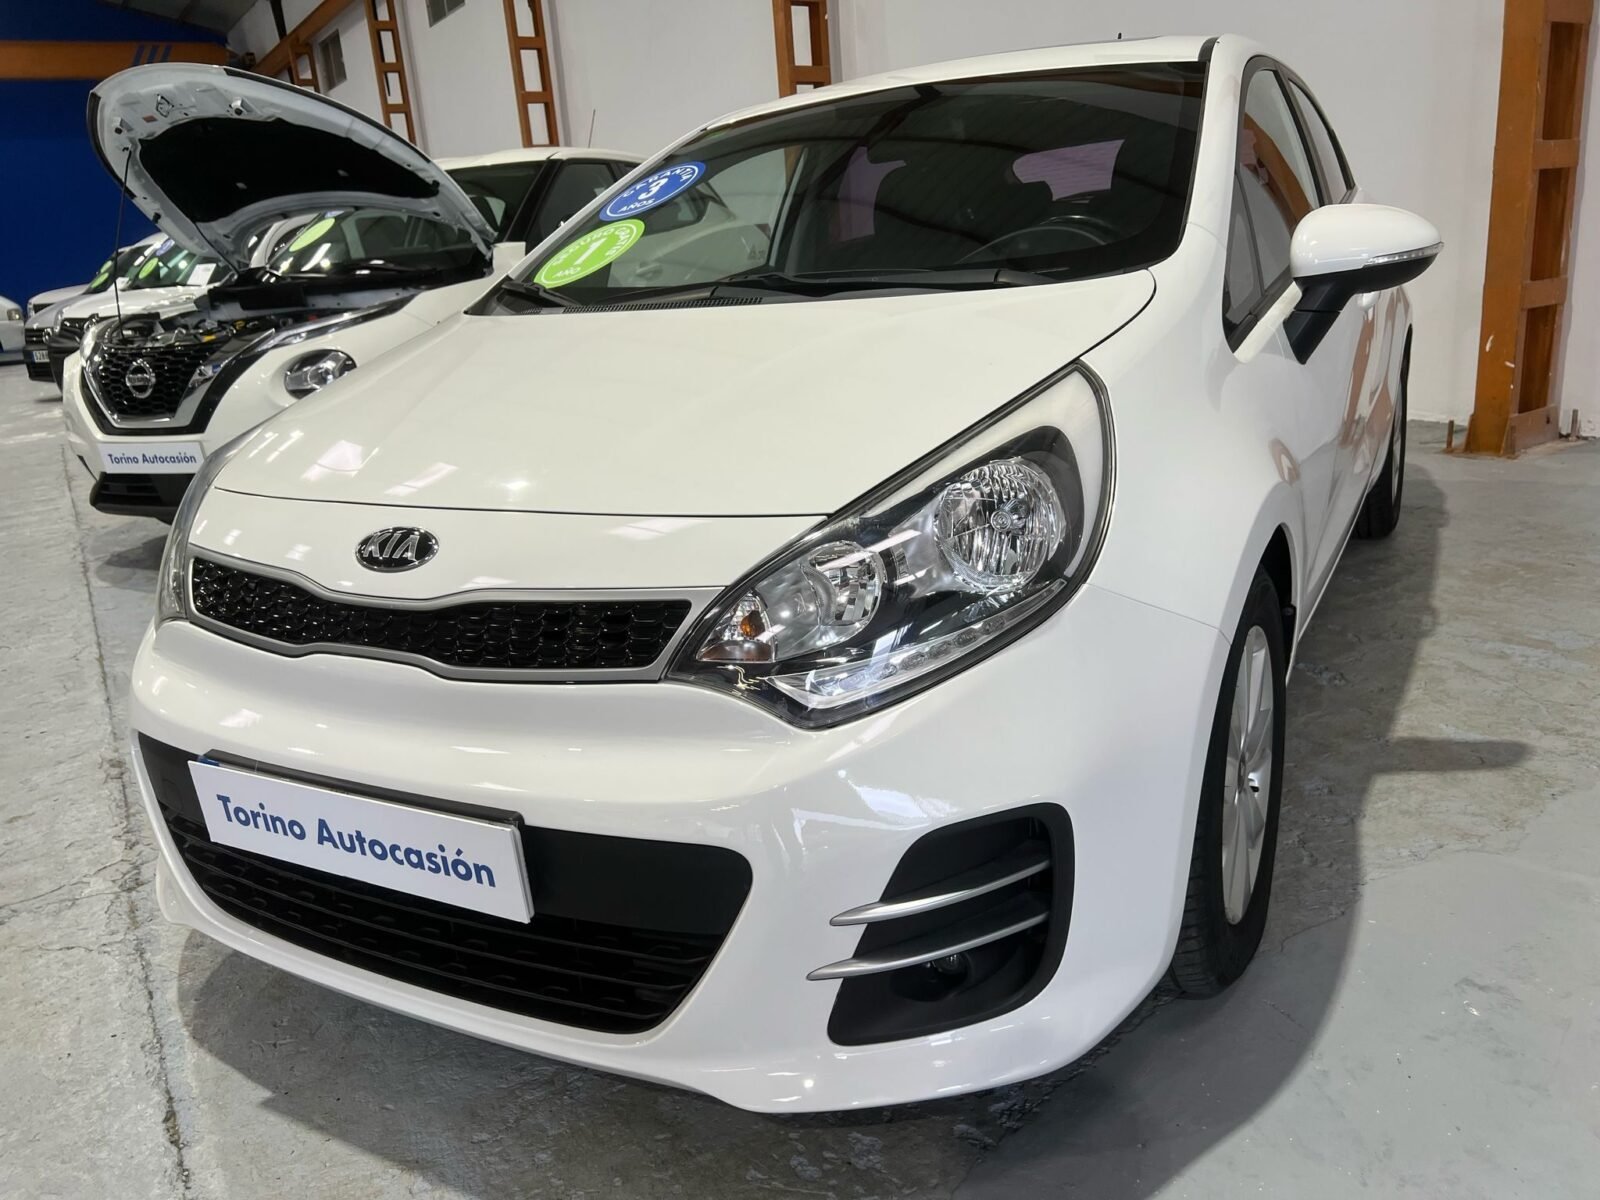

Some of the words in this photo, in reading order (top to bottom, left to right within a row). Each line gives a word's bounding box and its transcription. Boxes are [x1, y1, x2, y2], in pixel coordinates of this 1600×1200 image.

[637, 177, 669, 200] 3
[573, 236, 608, 265] 1
[107, 452, 140, 465] Torino
[142, 451, 197, 465] Autocasión
[362, 532, 420, 560] KIA
[216, 794, 306, 841] Torino
[317, 818, 496, 888] Autocasión
